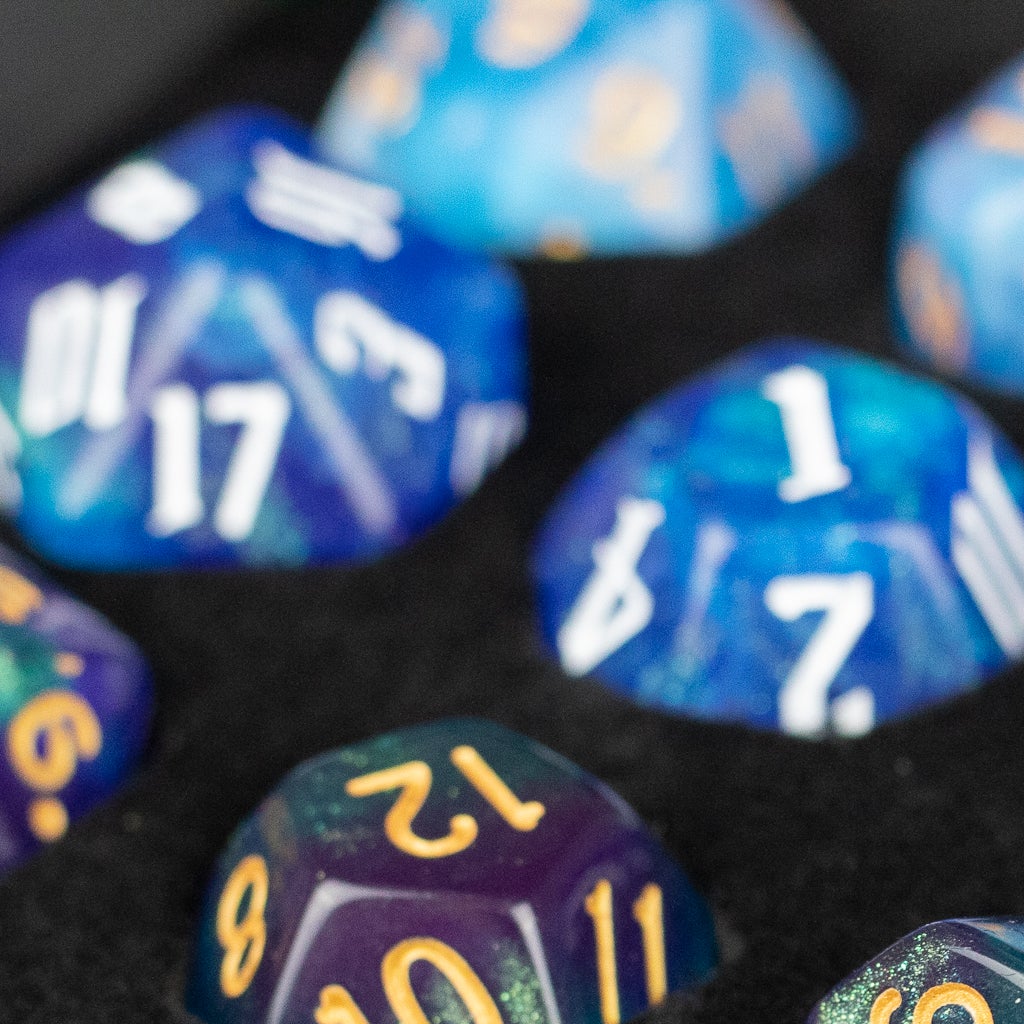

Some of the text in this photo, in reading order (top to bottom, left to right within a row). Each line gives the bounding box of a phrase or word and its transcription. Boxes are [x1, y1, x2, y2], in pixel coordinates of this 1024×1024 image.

[145, 380, 291, 542] 17
[764, 364, 852, 503] 1
[345, 744, 546, 859] 12
[216, 854, 270, 999] 8
